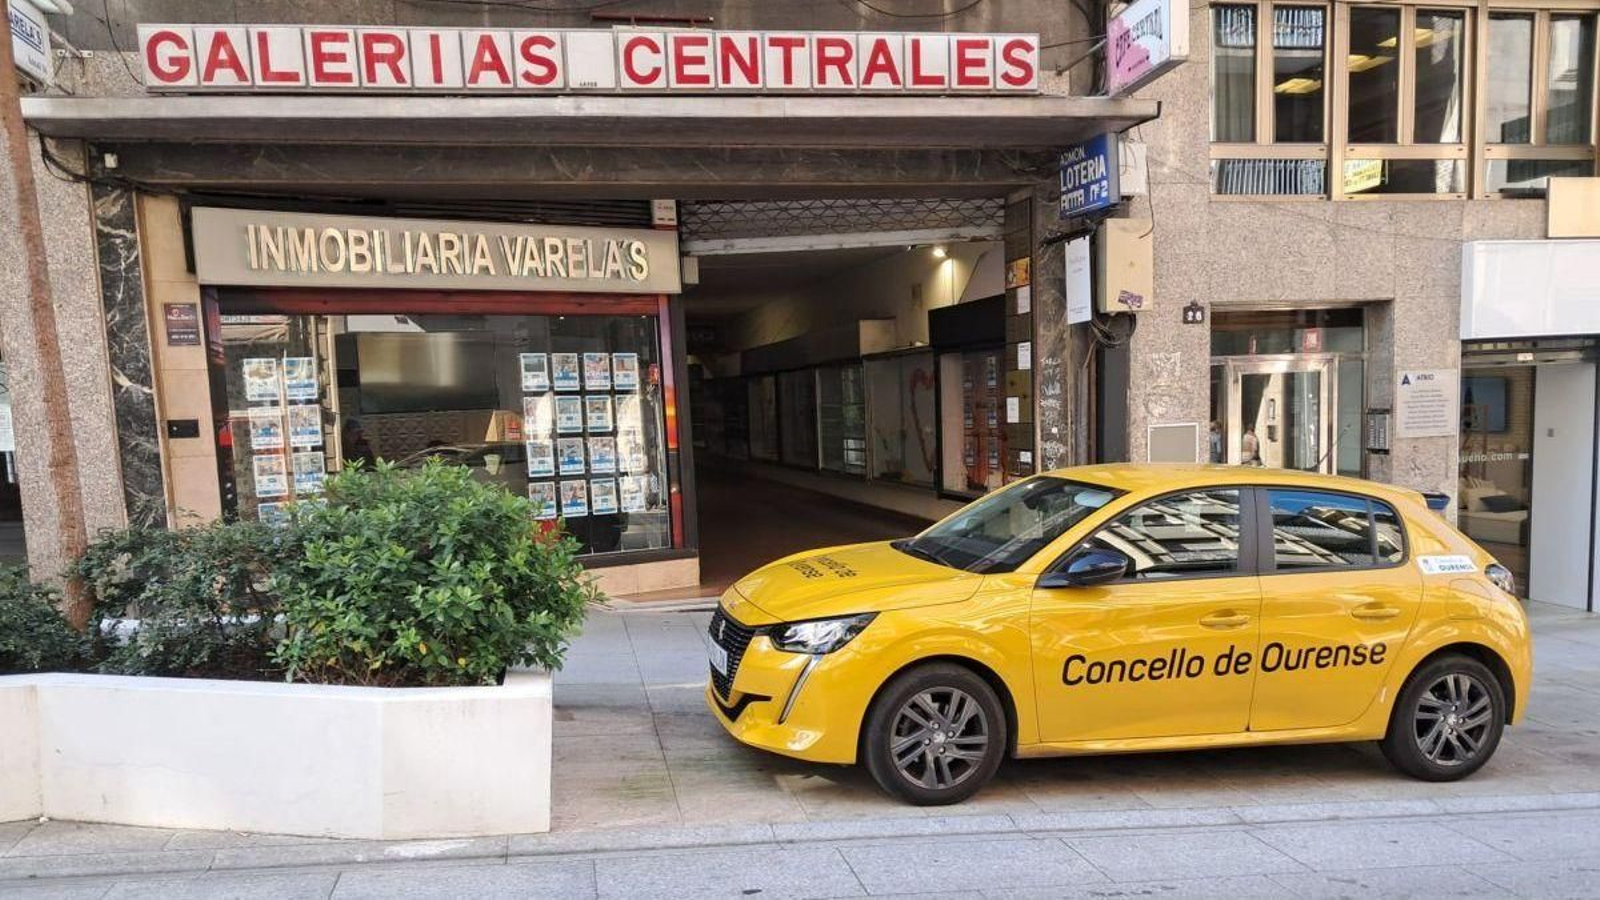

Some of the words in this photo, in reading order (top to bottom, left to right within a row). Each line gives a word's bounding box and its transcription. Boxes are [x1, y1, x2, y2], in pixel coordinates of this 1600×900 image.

[8, 9, 42, 46] ARELA'S
[145, 30, 559, 86] GALERIAS
[623, 35, 1034, 87] CENTRALES
[1060, 155, 1106, 191] LOTERIA
[245, 223, 496, 276] INMOBILIARIA
[500, 234, 650, 282] VARELA'S
[1061, 647, 1204, 686] Concello
[1213, 645, 1252, 677] de
[1260, 641, 1388, 673] Ourense
